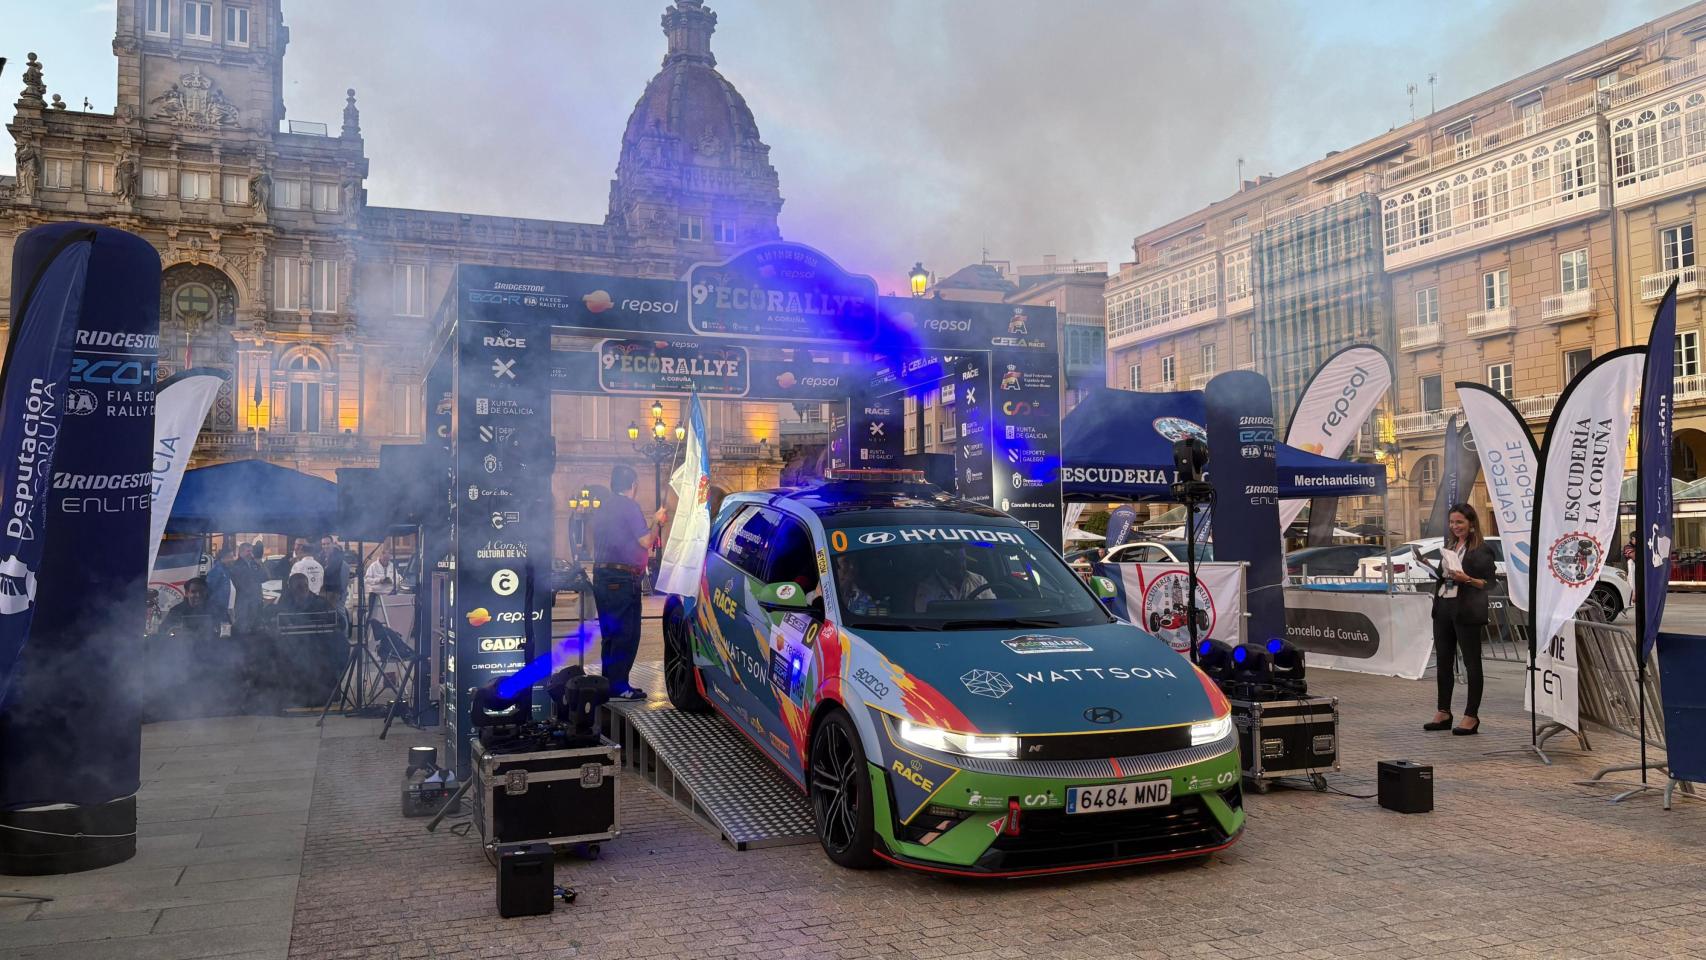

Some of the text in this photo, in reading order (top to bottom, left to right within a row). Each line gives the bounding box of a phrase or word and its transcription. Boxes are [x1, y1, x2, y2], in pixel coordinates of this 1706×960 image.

[494, 281, 545, 293] BRIDGESTONE
[621, 298, 679, 315] repsol
[924, 318, 972, 333] repsol
[76, 329, 159, 349] RIDGESTO
[483, 336, 527, 348] RACE
[992, 337, 1028, 347] CEEA
[801, 375, 839, 387] repsol
[962, 368, 979, 381] RACE
[107, 391, 131, 402] FIA
[1321, 366, 1369, 437] repsol
[106, 406, 146, 417] RALLY
[864, 407, 890, 415] RACE
[6, 377, 44, 540] Deputación
[1062, 467, 1168, 485] ESCUDERIA
[1564, 417, 1592, 522] ESCUDERÍA
[1585, 418, 1613, 524] LA CORUÑA
[1294, 473, 1376, 488] Merchandising
[900, 529, 1024, 545] HYUNDAI
[477, 550, 505, 558] CULTURA
[506, 550, 515, 558] DE
[713, 588, 738, 620] RACE
[496, 609, 544, 624] repol
[1323, 626, 1335, 638] da
[1337, 628, 1369, 642] Coruña
[723, 635, 767, 687] WATTSON
[1016, 667, 1178, 685] WATTSON
[892, 760, 934, 793] RACE
[1080, 781, 1168, 809] 6484 MND
